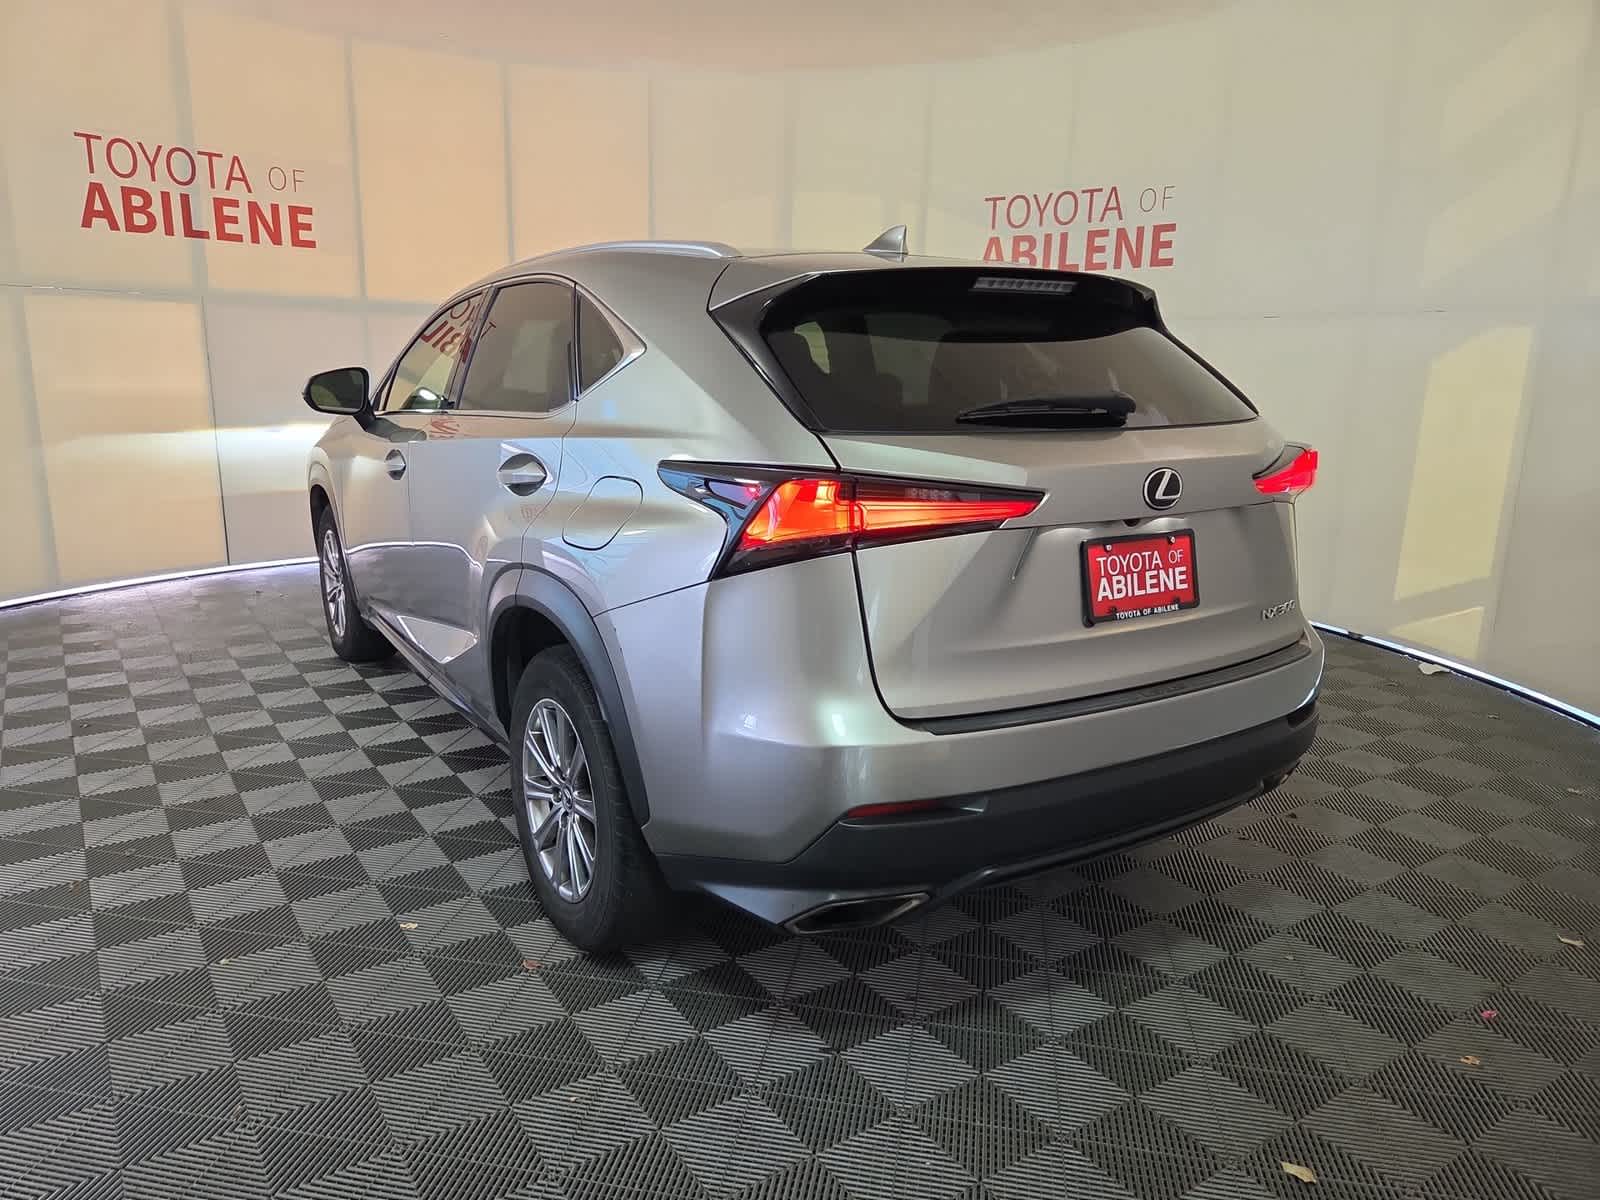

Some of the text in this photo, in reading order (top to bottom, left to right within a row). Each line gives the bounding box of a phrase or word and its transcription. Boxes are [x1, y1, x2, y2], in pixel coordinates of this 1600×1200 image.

[73, 131, 305, 193] TOYOTA OF
[81, 181, 317, 248] ABILENE
[985, 185, 1176, 230] TOYOTA OF
[983, 223, 1177, 272] ABILENE
[1096, 549, 1184, 576] TOYOTA OF
[1097, 566, 1188, 602] ABILENE
[1116, 603, 1179, 620] TOYOTA OF ABILENE
